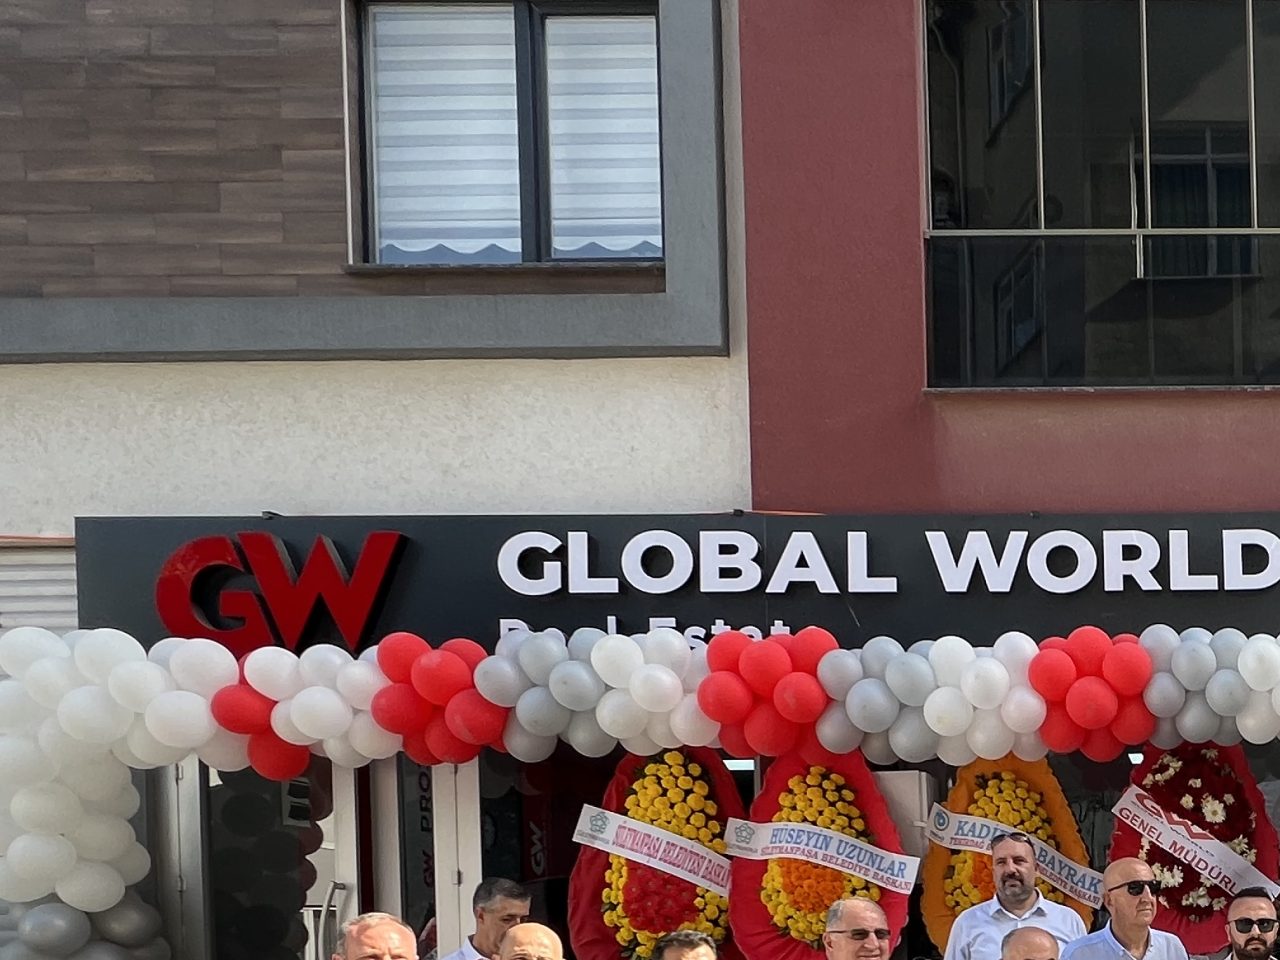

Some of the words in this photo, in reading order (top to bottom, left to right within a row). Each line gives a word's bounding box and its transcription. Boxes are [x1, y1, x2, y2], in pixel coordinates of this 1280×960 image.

[496, 529, 898, 596] GLOBAL
[155, 530, 403, 659] GW
[418, 769, 434, 832] PRO
[769, 823, 834, 851] HÜSEYİN
[836, 839, 908, 879] UZUNLAR
[820, 853, 871, 878] BELEDİYE
[1036, 846, 1104, 895] BAYRAK
[1118, 806, 1165, 845] GENEL
[1168, 839, 1242, 898] MÜDÜRL
